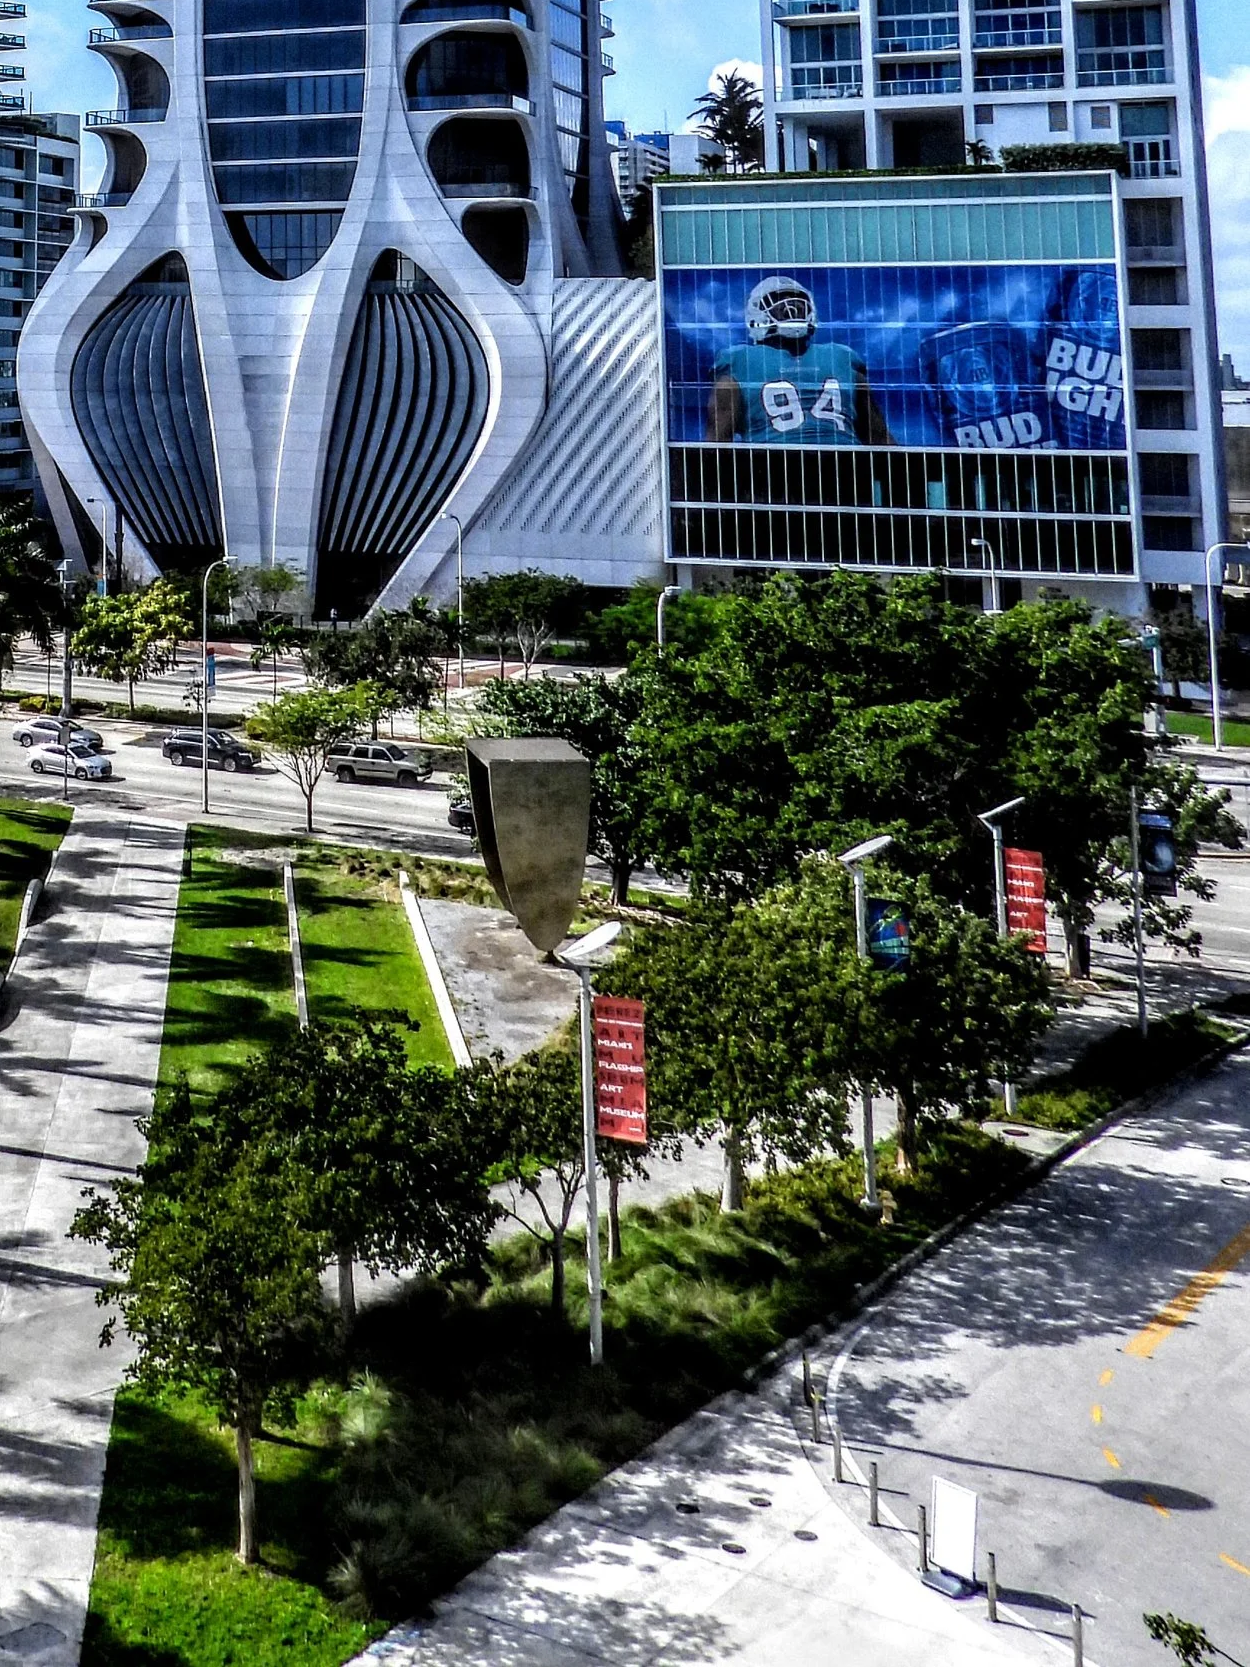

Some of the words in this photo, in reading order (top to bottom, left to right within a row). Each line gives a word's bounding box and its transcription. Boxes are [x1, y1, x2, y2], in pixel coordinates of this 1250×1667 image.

[760, 378, 846, 432] 94
[954, 411, 1042, 449] BUD
[599, 1060, 644, 1073] FLAGSHIP
[600, 1083, 624, 1094] ART
[599, 1105, 645, 1120] MUSEUM
